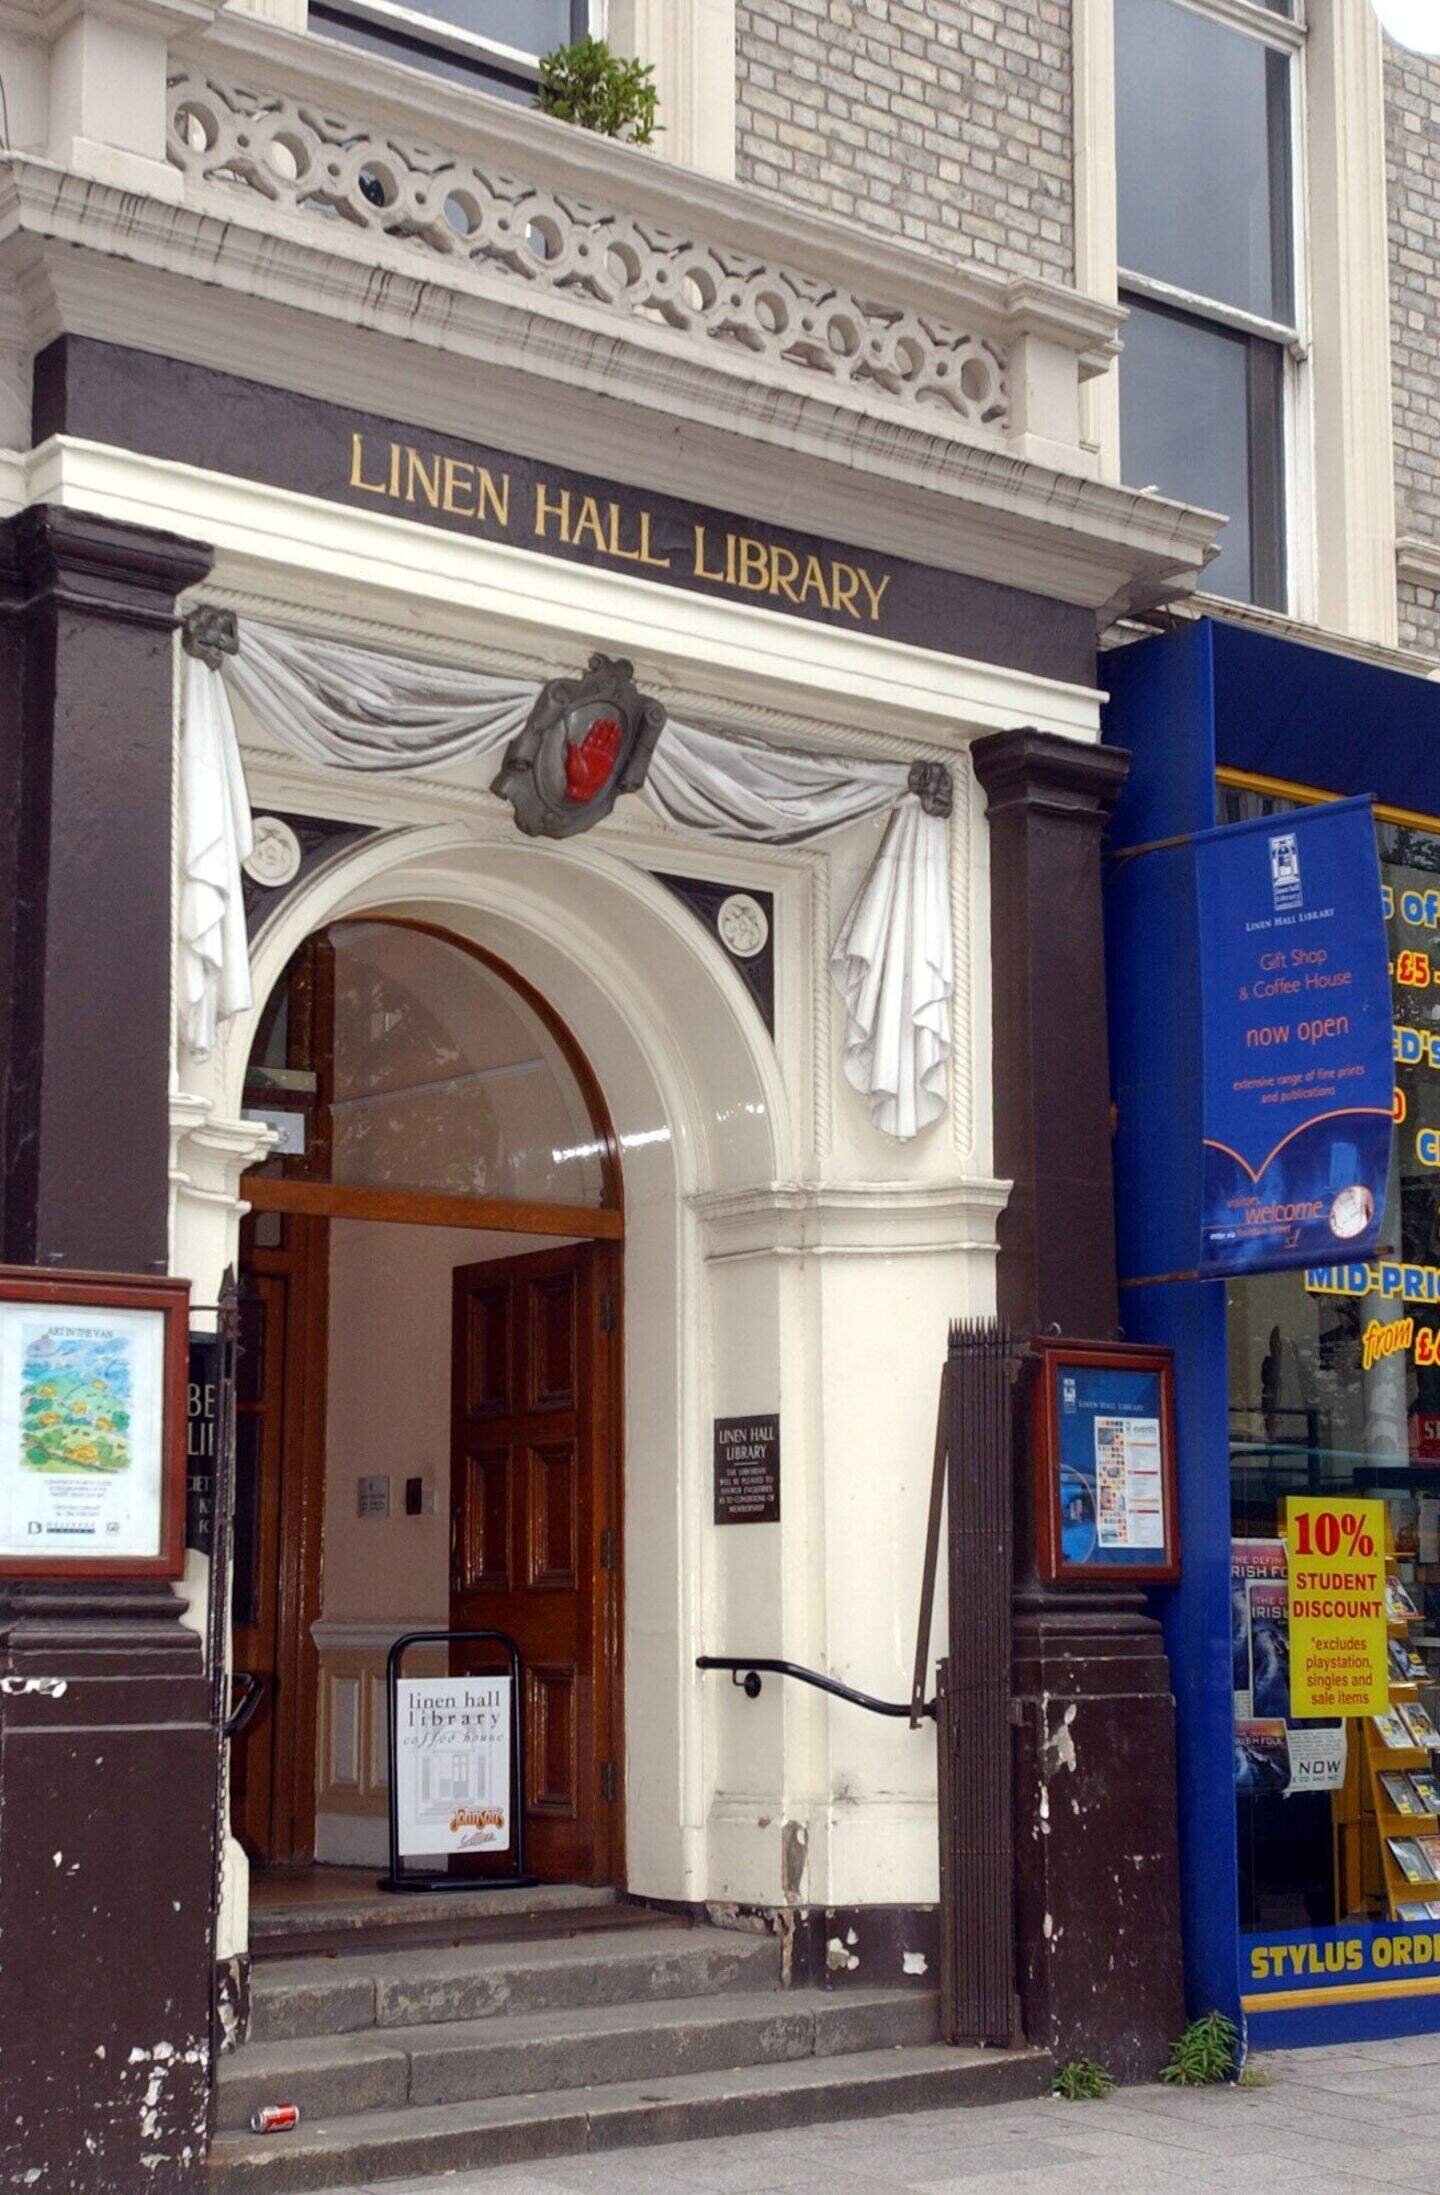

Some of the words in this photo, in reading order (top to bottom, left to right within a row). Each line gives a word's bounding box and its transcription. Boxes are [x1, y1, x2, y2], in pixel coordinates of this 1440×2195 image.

[350, 432, 510, 526] LINEN
[534, 483, 671, 568] HALL
[694, 525, 891, 621] LIBRARY
[1274, 914, 1297, 927] HALL
[1299, 908, 1335, 922] LIBRARY
[1260, 952, 1287, 971] Gift
[1291, 949, 1328, 966] Shop
[1238, 986, 1249, 1001] &
[1253, 977, 1301, 998] Coffee
[1305, 971, 1352, 990] House
[1246, 1025, 1290, 1047] now
[1297, 1016, 1349, 1045] open
[1233, 1077, 1275, 1091] extensive
[1276, 1074, 1303, 1087] range
[1305, 1069, 1316, 1082] of
[1317, 1067, 1336, 1079] fine
[1337, 1065, 1365, 1080] prints
[1261, 1092, 1280, 1104] and
[1281, 1086, 1336, 1102] publications
[1246, 1200, 1323, 1225] welcome
[720, 1430, 747, 1444] LINEN
[750, 1426, 775, 1441] HALL
[726, 1445, 767, 1461] LIBRARY
[1296, 1572, 1378, 1592] STUDENT
[1293, 1600, 1383, 1618] DISCOUNT
[1306, 1673, 1349, 1690] singles
[1351, 1673, 1373, 1686] and
[409, 1693, 456, 1709] linen
[465, 1690, 500, 1708] hall
[1311, 1691, 1335, 1705] sale
[1337, 1690, 1370, 1705] items
[409, 1710, 501, 1731] library
[1299, 1760, 1340, 1775] NOW
[1251, 1939, 1364, 1980] STYLUS
